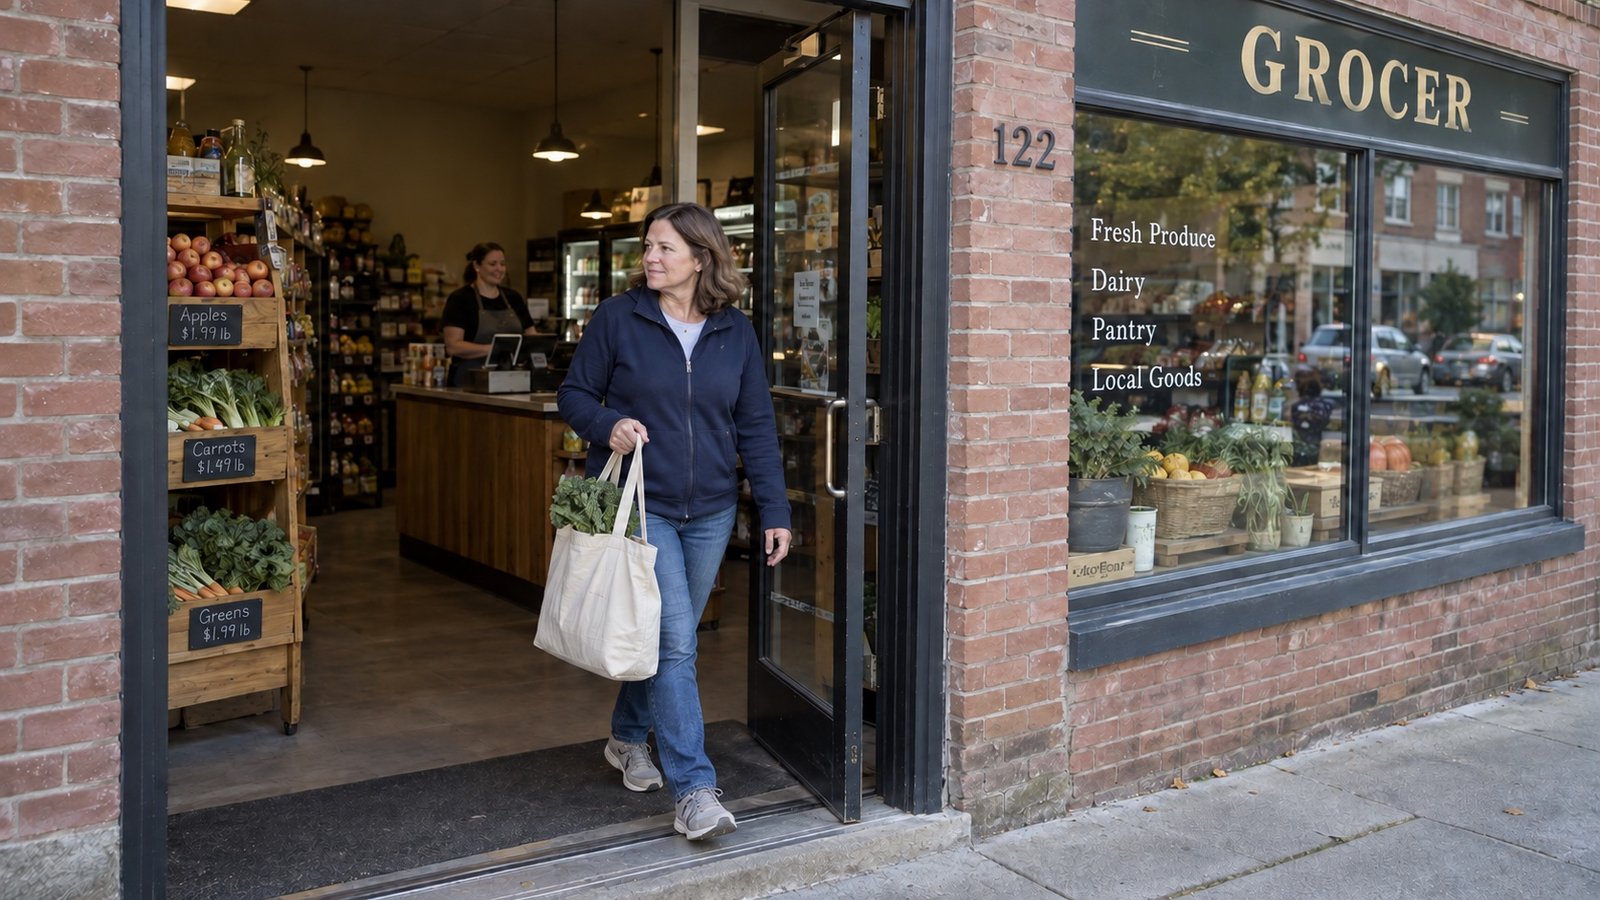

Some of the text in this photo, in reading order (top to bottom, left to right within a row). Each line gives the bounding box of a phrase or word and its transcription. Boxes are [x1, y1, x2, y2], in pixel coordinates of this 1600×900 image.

[1241, 25, 1472, 133] GROCER
[993, 122, 1056, 171] 122
[1090, 217, 1216, 248] Fresh Produce
[1091, 268, 1145, 299] Dairy
[180, 306, 228, 326] Apples
[181, 326, 231, 340] $1.99 lb
[1091, 317, 1157, 346] Pantry
[1091, 365, 1202, 391] Local Goods
[192, 440, 246, 457] Carrots
[197, 457, 245, 475] $1.49 lb
[199, 607, 250, 625] Greens
[203, 623, 251, 643] $1.99 lb
